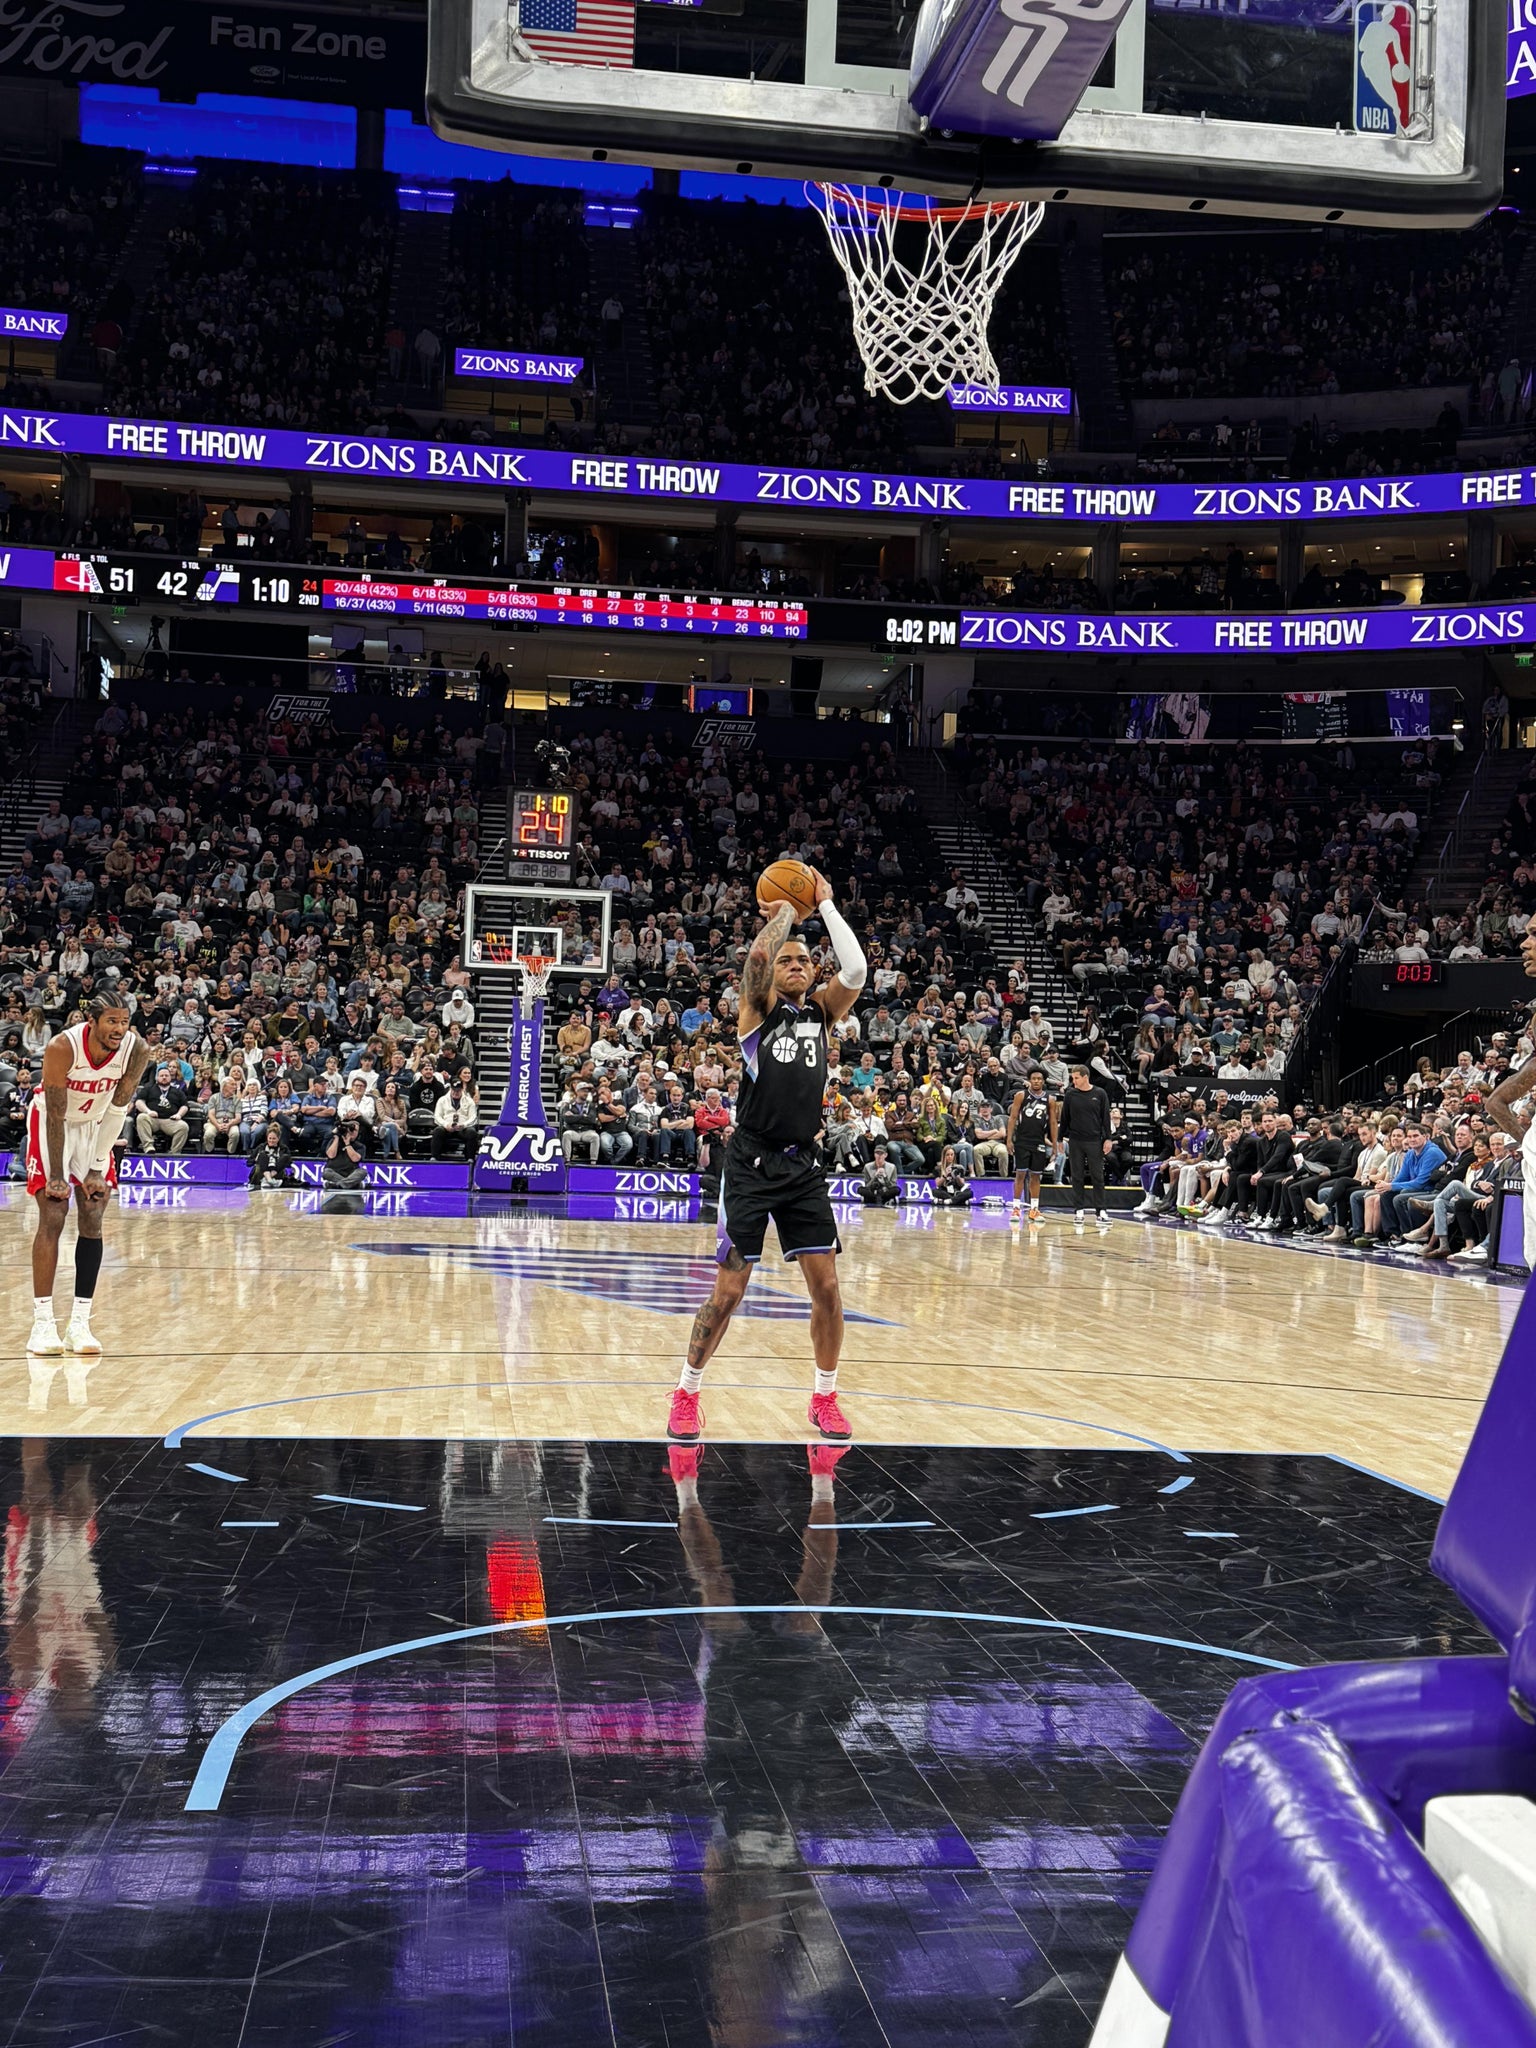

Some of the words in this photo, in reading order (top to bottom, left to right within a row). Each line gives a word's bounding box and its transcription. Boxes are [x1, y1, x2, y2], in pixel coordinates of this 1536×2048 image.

[0, 0, 175, 80] Ford
[210, 15, 281, 51] Fan
[291, 23, 387, 60] Zone
[1362, 106, 1390, 131] NBA
[4, 315, 62, 335] BANK
[462, 354, 520, 374] ZIONS
[525, 360, 577, 378] BANK
[952, 390, 1008, 406] ZIONS
[1014, 392, 1064, 409] BANK
[107, 423, 169, 454] FREE
[176, 428, 267, 461] THROW
[305, 438, 416, 473] ZIONS
[426, 448, 528, 482] BANK
[571, 459, 629, 488] FREE
[635, 463, 720, 494] THROW
[1461, 473, 1523, 504] FREE
[756, 471, 862, 504] ZIONS
[871, 479, 967, 511] BANK
[1009, 486, 1065, 514] FREE
[1072, 488, 1156, 516] THROW
[1192, 487, 1302, 515] ZIONS
[1312, 481, 1415, 513] BANK
[67, 553, 81, 562] FLS
[90, 554, 95, 563] 5
[96, 555, 109, 564] TOL
[182, 561, 187, 569] 5
[187, 562, 200, 570] TOL
[215, 563, 221, 571] 5
[221, 564, 234, 572] FLS
[84, 563, 101, 592] BONUS
[109, 567, 134, 593] 51
[156, 571, 188, 596] 42
[251, 577, 290, 603] 1:10
[302, 580, 318, 592] 24
[361, 574, 372, 583] FG
[433, 578, 447, 587] 3PT
[509, 584, 518, 592] FT
[607, 590, 621, 599] REB
[633, 592, 647, 601] AST
[659, 594, 672, 603] STL
[684, 595, 698, 604] BLK
[709, 597, 723, 605] TOV
[298, 594, 320, 606] 2ND
[334, 582, 368, 595] 20/48
[369, 583, 398, 598] (42%)
[412, 587, 437, 600] 6/18
[438, 588, 467, 602] (33%)
[488, 592, 508, 604] 5/8
[509, 593, 538, 607] (63%)
[558, 597, 566, 608] 9
[581, 599, 593, 610] 18
[607, 600, 620, 611] 27
[633, 602, 645, 613] 12
[660, 604, 669, 614] 2
[686, 606, 694, 616] 3
[711, 607, 719, 617] 4
[735, 609, 749, 619] 23
[759, 610, 775, 621] 110
[785, 612, 799, 622] 94
[335, 597, 366, 609] 16/37
[366, 598, 396, 612] (43%)
[413, 602, 435, 613] 5/11
[436, 603, 465, 617] (45%)
[487, 607, 507, 619] 5/6
[508, 608, 538, 621] (83%)
[557, 612, 565, 622] 2
[581, 613, 593, 624] 16
[607, 615, 619, 625] 18
[633, 616, 644, 627] 13
[660, 618, 668, 629] 3
[685, 620, 694, 630] 4
[711, 621, 719, 632] 7
[734, 623, 749, 634] 26
[759, 624, 774, 635] 94
[784, 625, 800, 637] 110
[1410, 610, 1525, 643] ZIONS
[886, 618, 924, 643] 8:02
[927, 620, 957, 645] PM
[961, 615, 1066, 646] ZIONS
[1076, 621, 1174, 648] BANK
[1214, 621, 1273, 647] FREE
[1280, 618, 1368, 647] THROW
[269, 698, 289, 720] 5
[295, 699, 309, 707] FOR
[699, 723, 718, 745] 5
[535, 794, 569, 814] 1:10
[520, 811, 564, 845] 24
[528, 849, 570, 861] TISSOT
[1397, 964, 1432, 982] 8:03
[521, 1025, 532, 1061] FIRST
[803, 1038, 817, 1068] 3
[517, 1062, 531, 1120] AMERICA
[78, 1098, 94, 1114] 4
[1035, 1108, 1042, 1120] 2
[120, 1158, 192, 1180] BANK
[481, 1160, 528, 1171] AMERICA
[528, 1162, 559, 1172] FIRST
[614, 1171, 691, 1193] ZIONS
